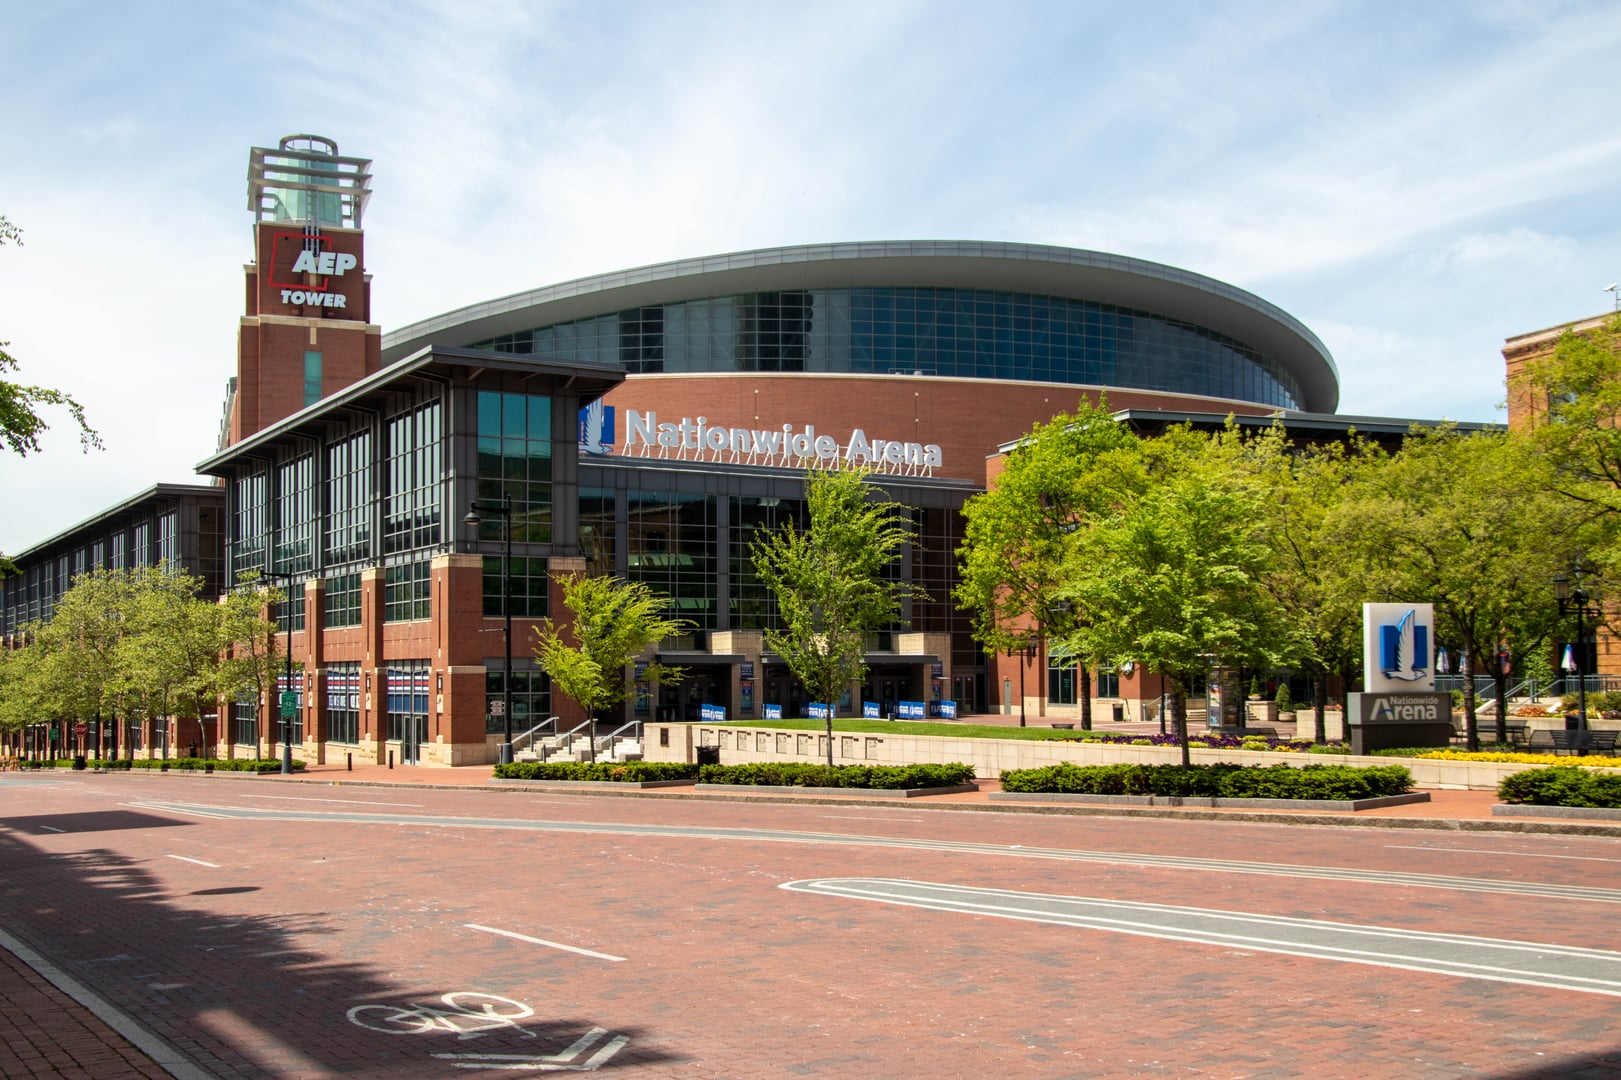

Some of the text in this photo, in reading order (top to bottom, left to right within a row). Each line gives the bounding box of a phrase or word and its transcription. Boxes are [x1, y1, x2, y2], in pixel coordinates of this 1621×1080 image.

[291, 250, 357, 276] AEP
[280, 290, 347, 309] TOWER
[626, 409, 943, 467] Nationwide Arena
[1370, 698, 1438, 720] Arena
[1389, 696, 1440, 705] Nationwide
